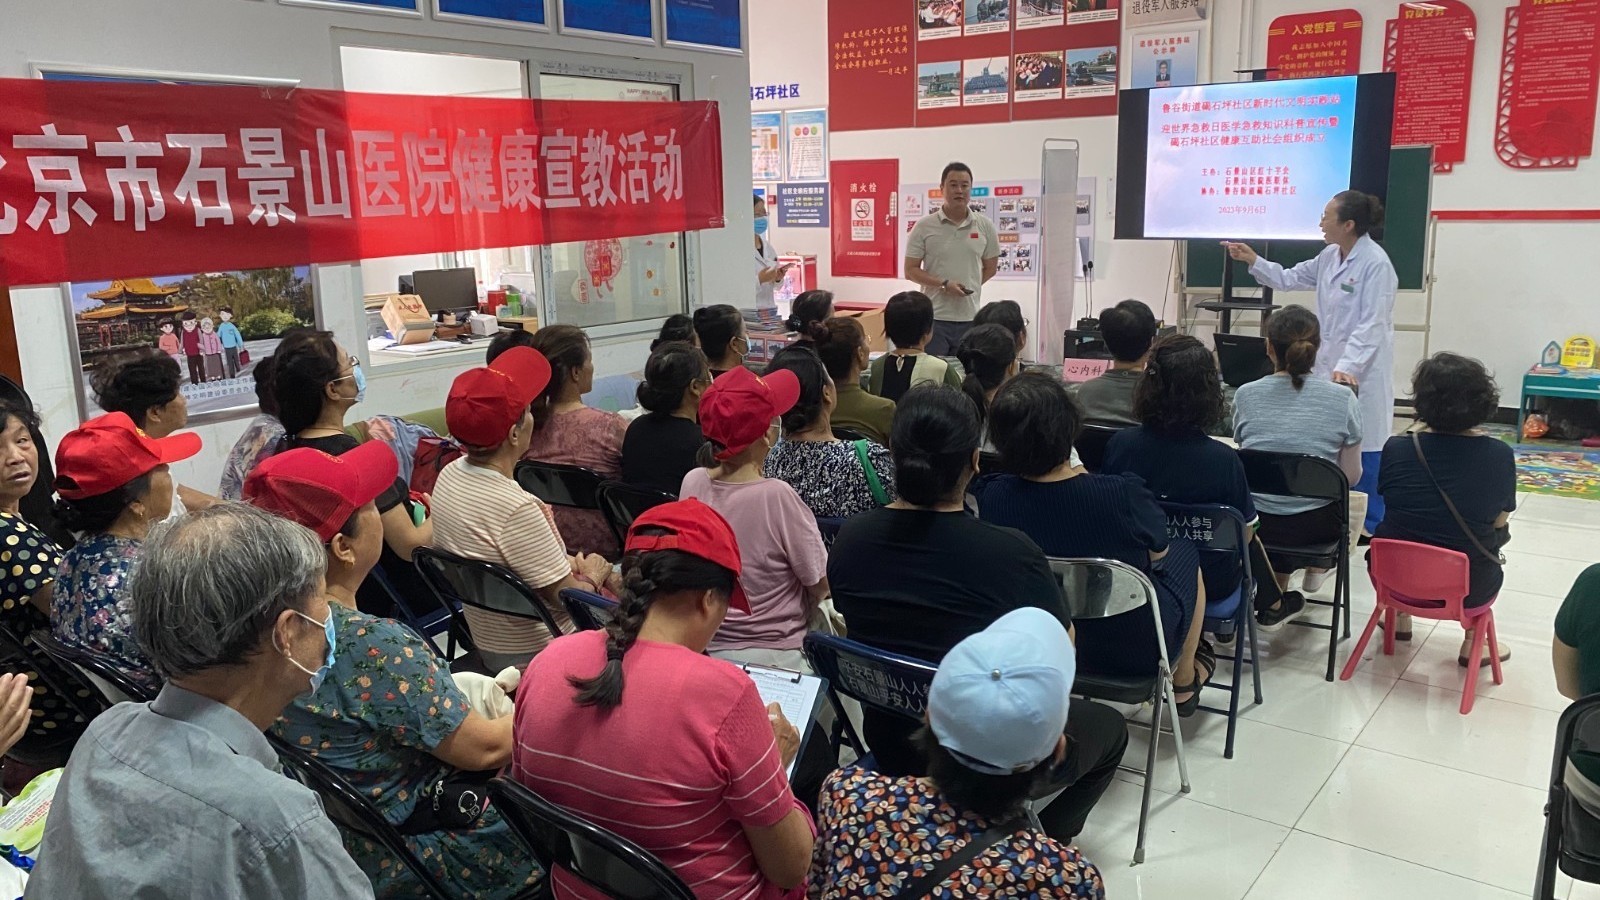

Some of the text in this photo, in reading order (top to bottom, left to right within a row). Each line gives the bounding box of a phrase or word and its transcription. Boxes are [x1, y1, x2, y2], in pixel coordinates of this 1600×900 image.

[1291, 21, 1337, 36] 入党誓言
[1140, 36, 1190, 48] 退役军人服务站
[850, 182, 877, 193] 消火栓
[1218, 205, 1267, 214] 2023年9月6日
[1068, 364, 1102, 377] 心内科
